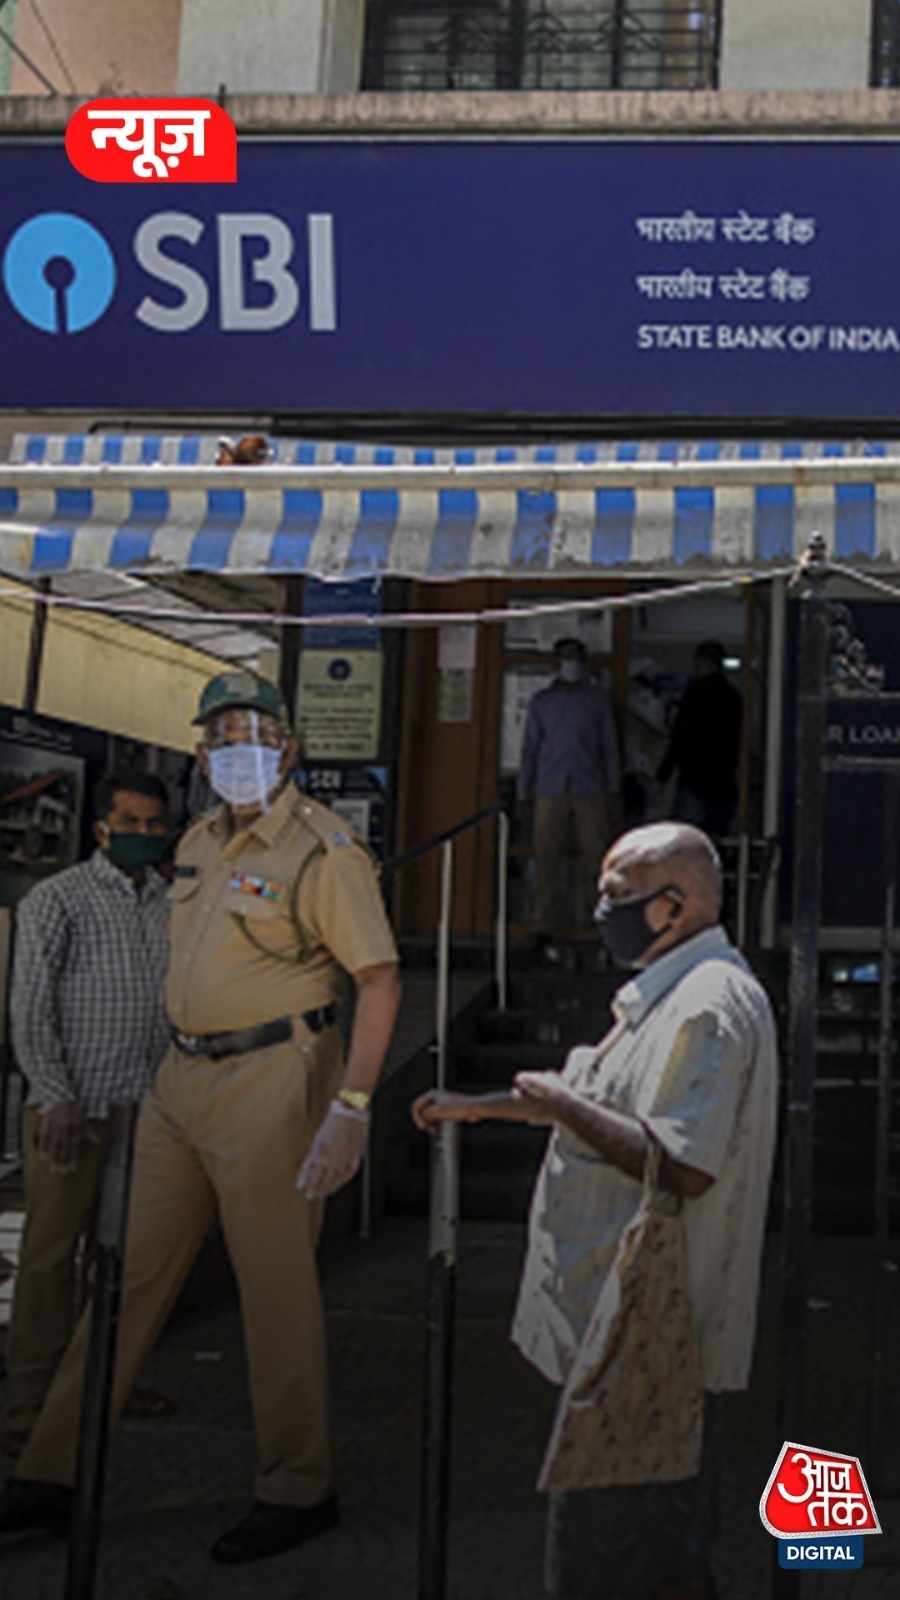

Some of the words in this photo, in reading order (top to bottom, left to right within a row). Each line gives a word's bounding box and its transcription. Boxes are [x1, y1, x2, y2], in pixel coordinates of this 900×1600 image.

[636, 209, 716, 241] भारतीय
[721, 209, 769, 241] स्टेट
[134, 211, 336, 332] SBI
[636, 267, 713, 298] भारतीय
[718, 268, 765, 298] स्टेट
[637, 325, 711, 347] STATE
[717, 326, 785, 348] BANK
[788, 326, 826, 349] OF
[828, 328, 900, 350] INDIA
